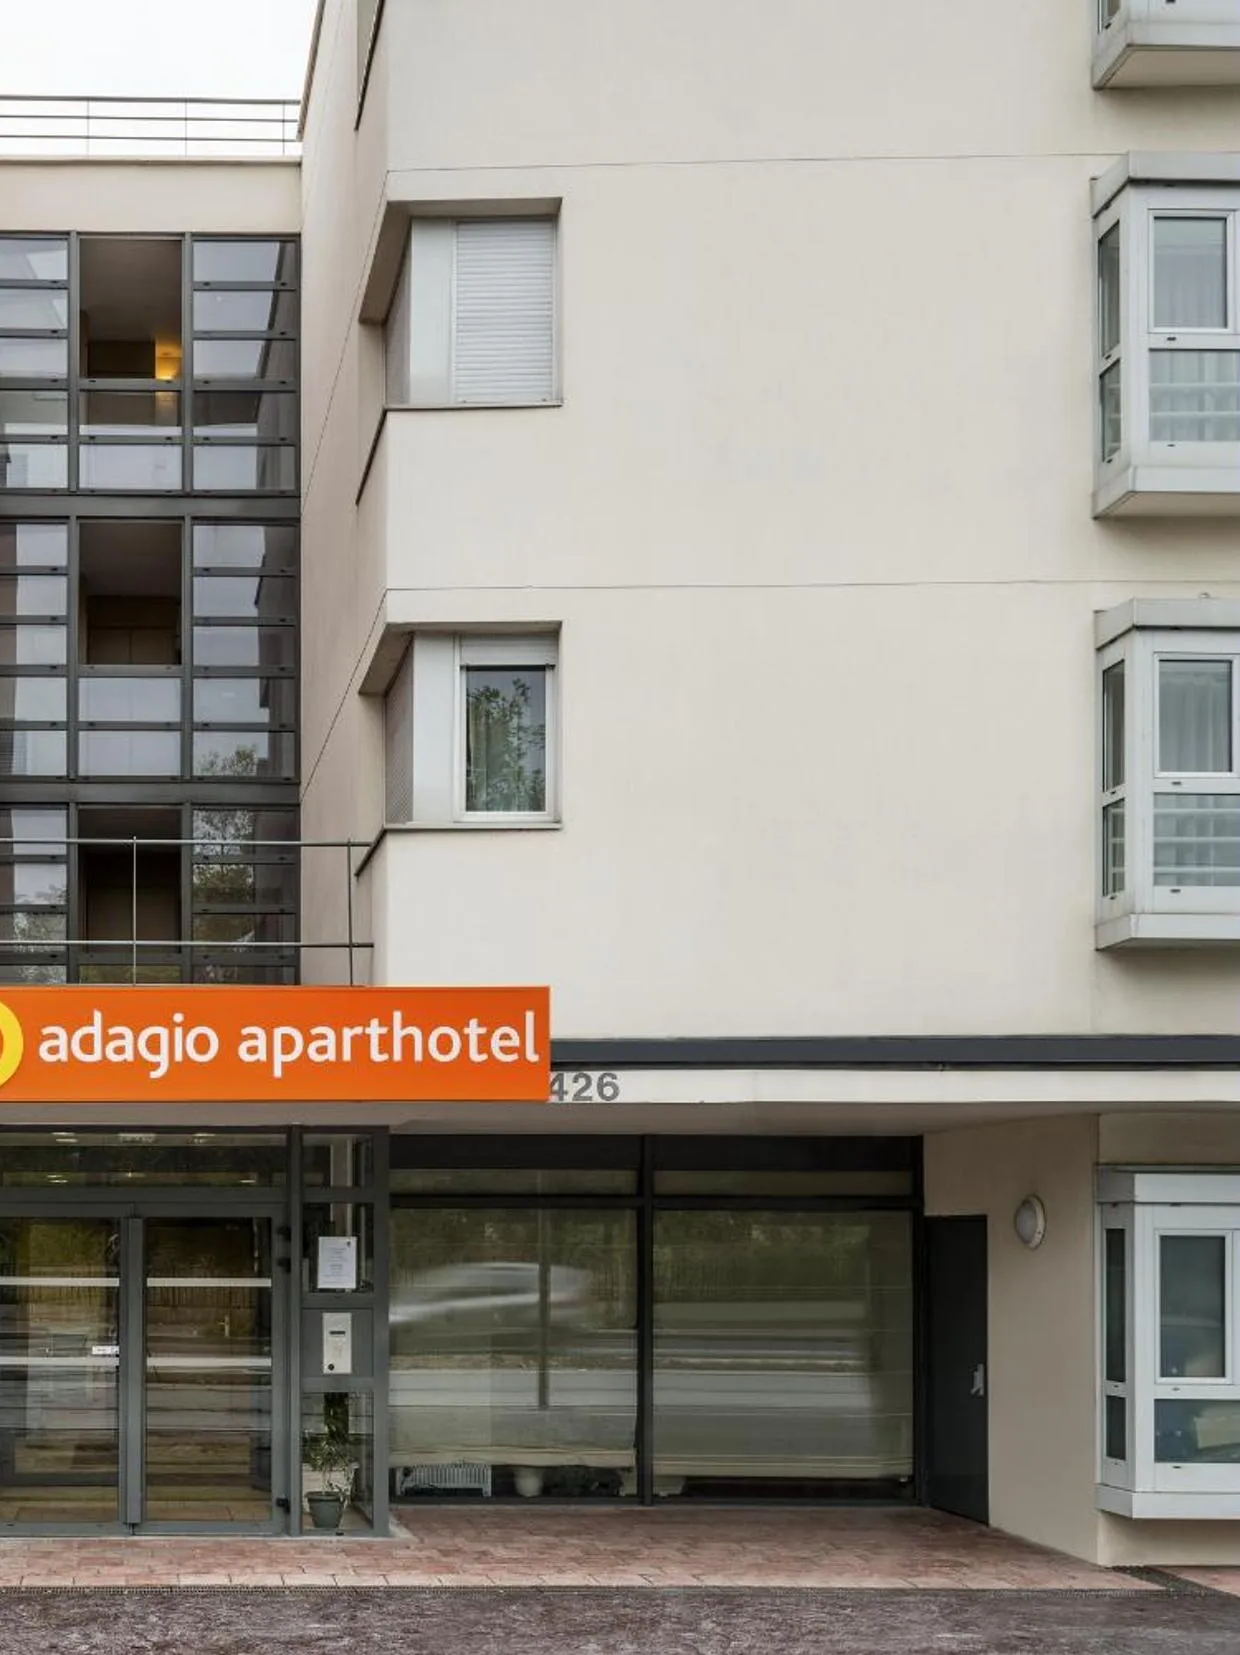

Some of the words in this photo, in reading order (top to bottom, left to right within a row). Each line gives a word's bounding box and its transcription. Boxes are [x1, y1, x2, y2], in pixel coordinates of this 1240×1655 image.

[38, 1009, 220, 1079] adagio
[237, 1009, 540, 1079] aparthotel
[550, 1072, 620, 1102] 426
